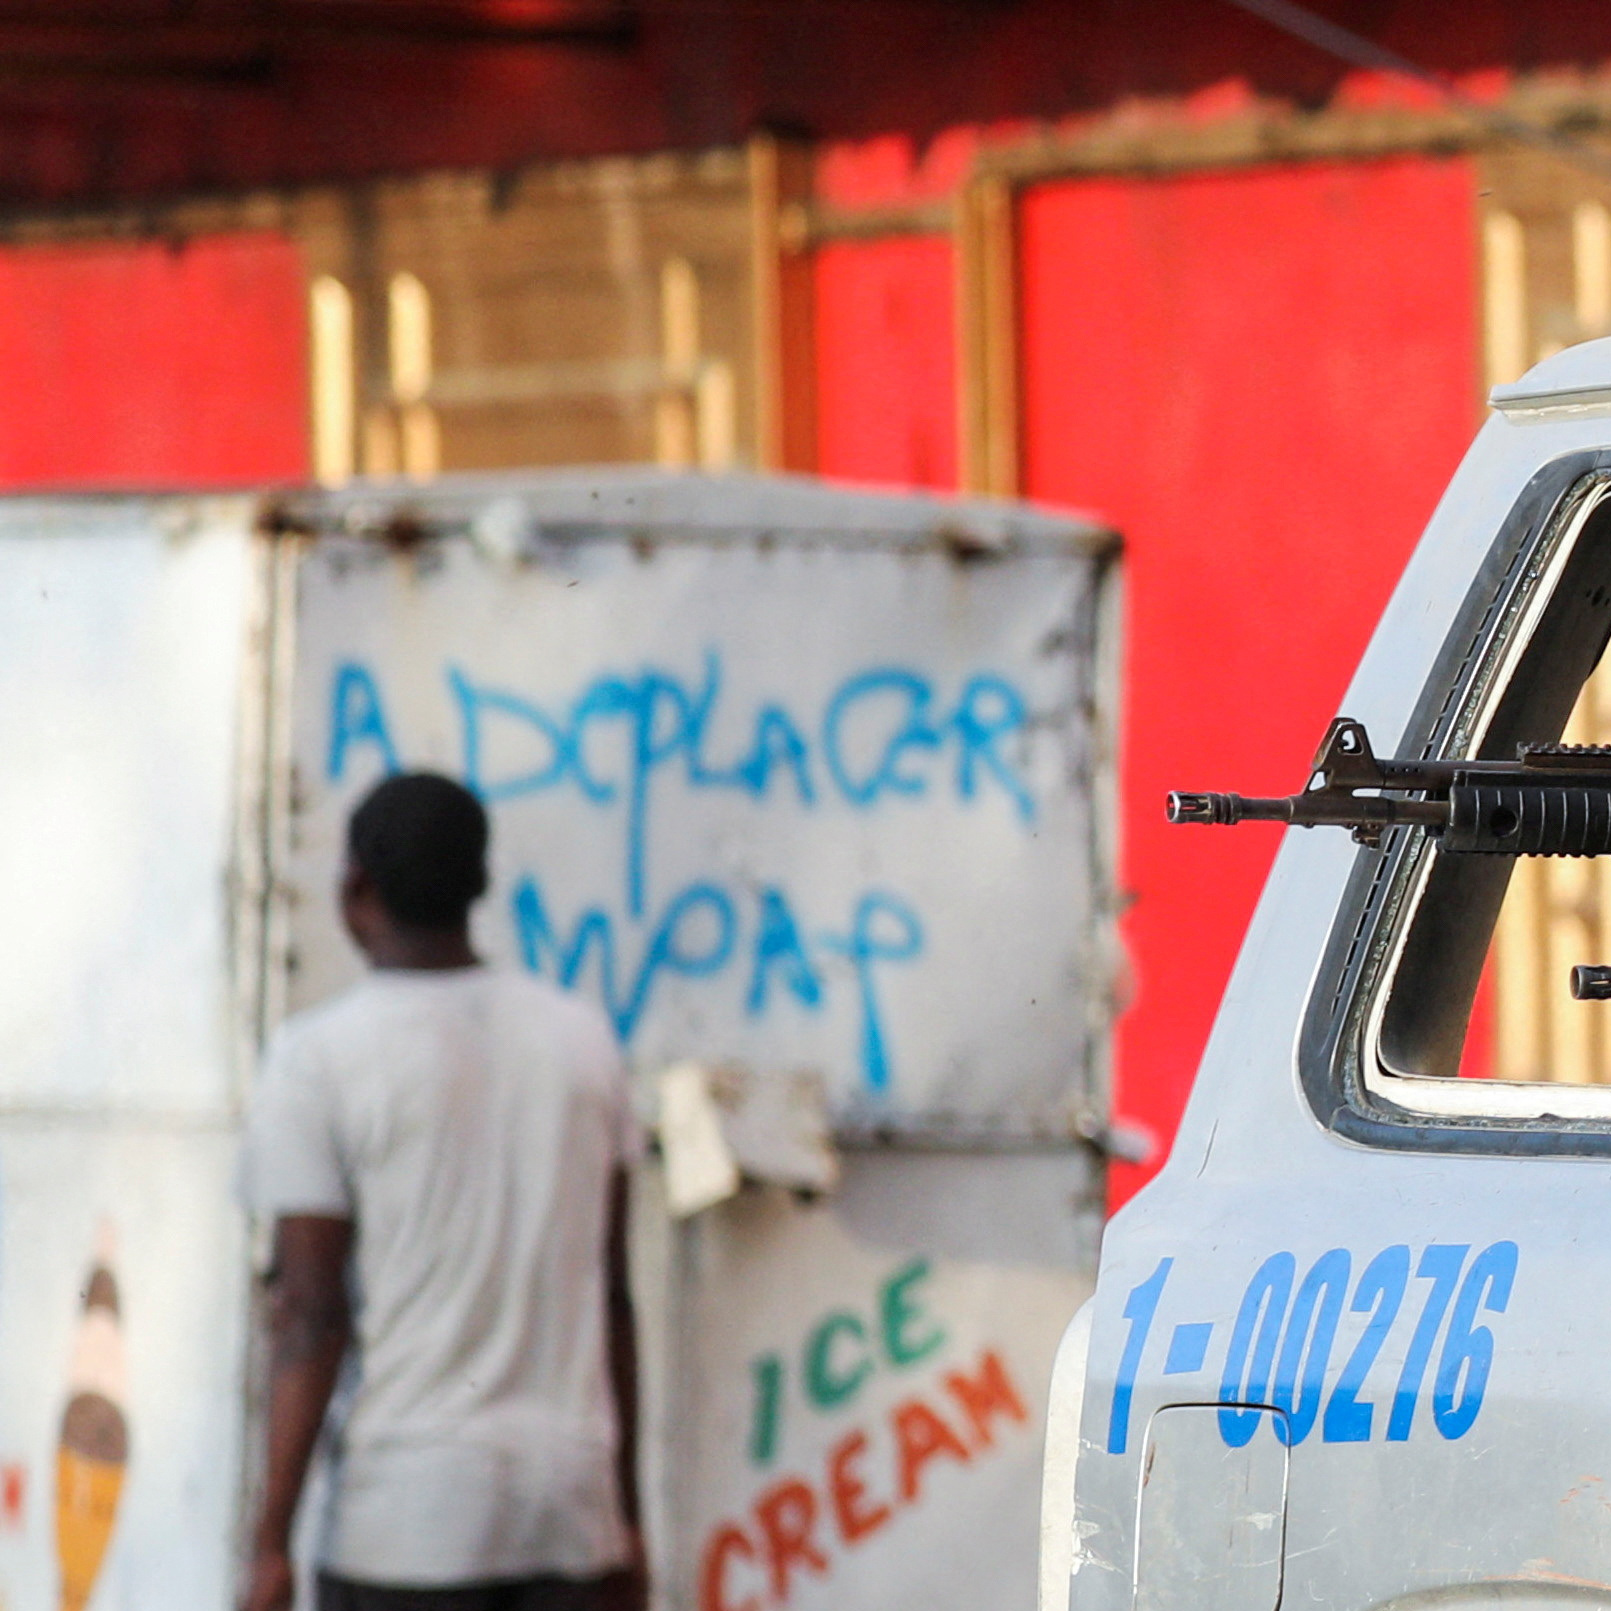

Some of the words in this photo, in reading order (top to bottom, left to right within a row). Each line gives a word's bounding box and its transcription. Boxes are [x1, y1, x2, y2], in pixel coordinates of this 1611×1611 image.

[327, 661, 400, 783] A
[750, 1257, 948, 1463] ICE
[1108, 1240, 1518, 1454] 1-00276
